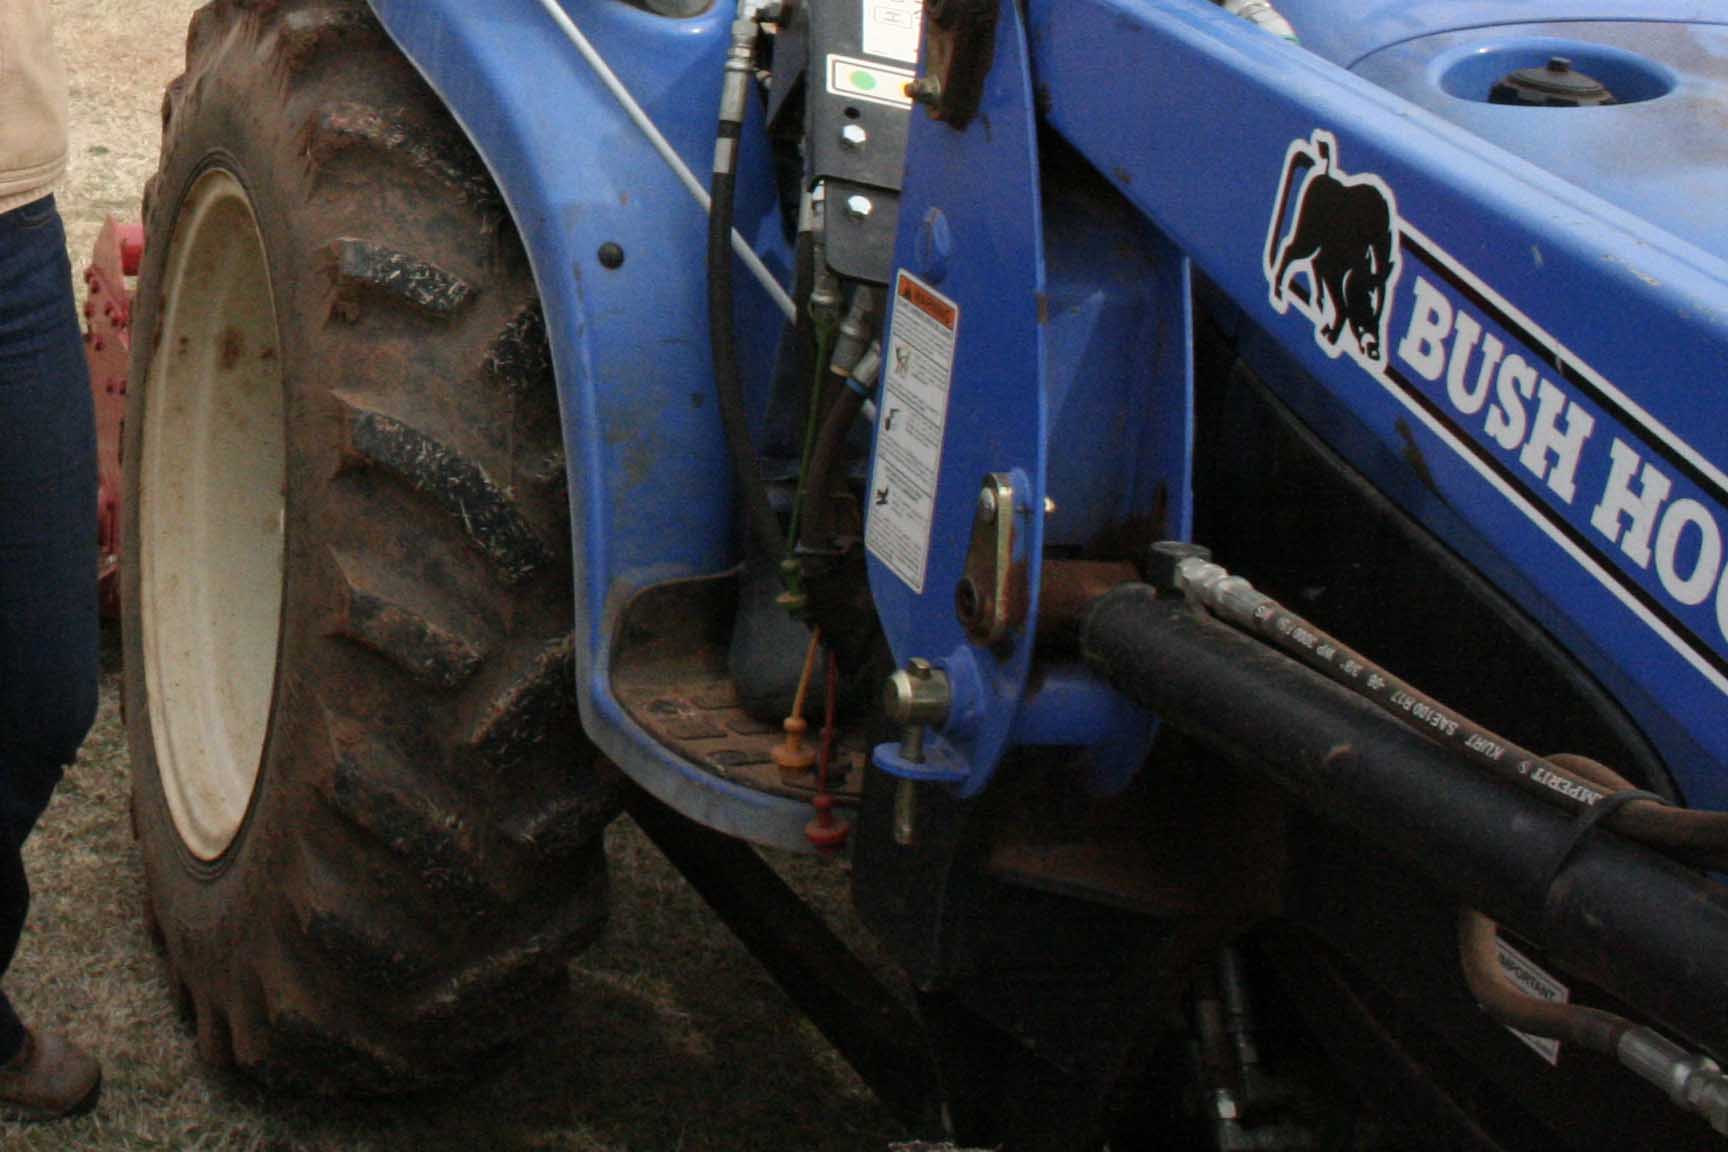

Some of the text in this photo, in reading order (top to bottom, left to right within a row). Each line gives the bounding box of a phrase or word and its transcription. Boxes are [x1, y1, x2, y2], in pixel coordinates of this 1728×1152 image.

[1399, 276, 1728, 643] BUSH HO
[1464, 734, 1505, 761] KURT
